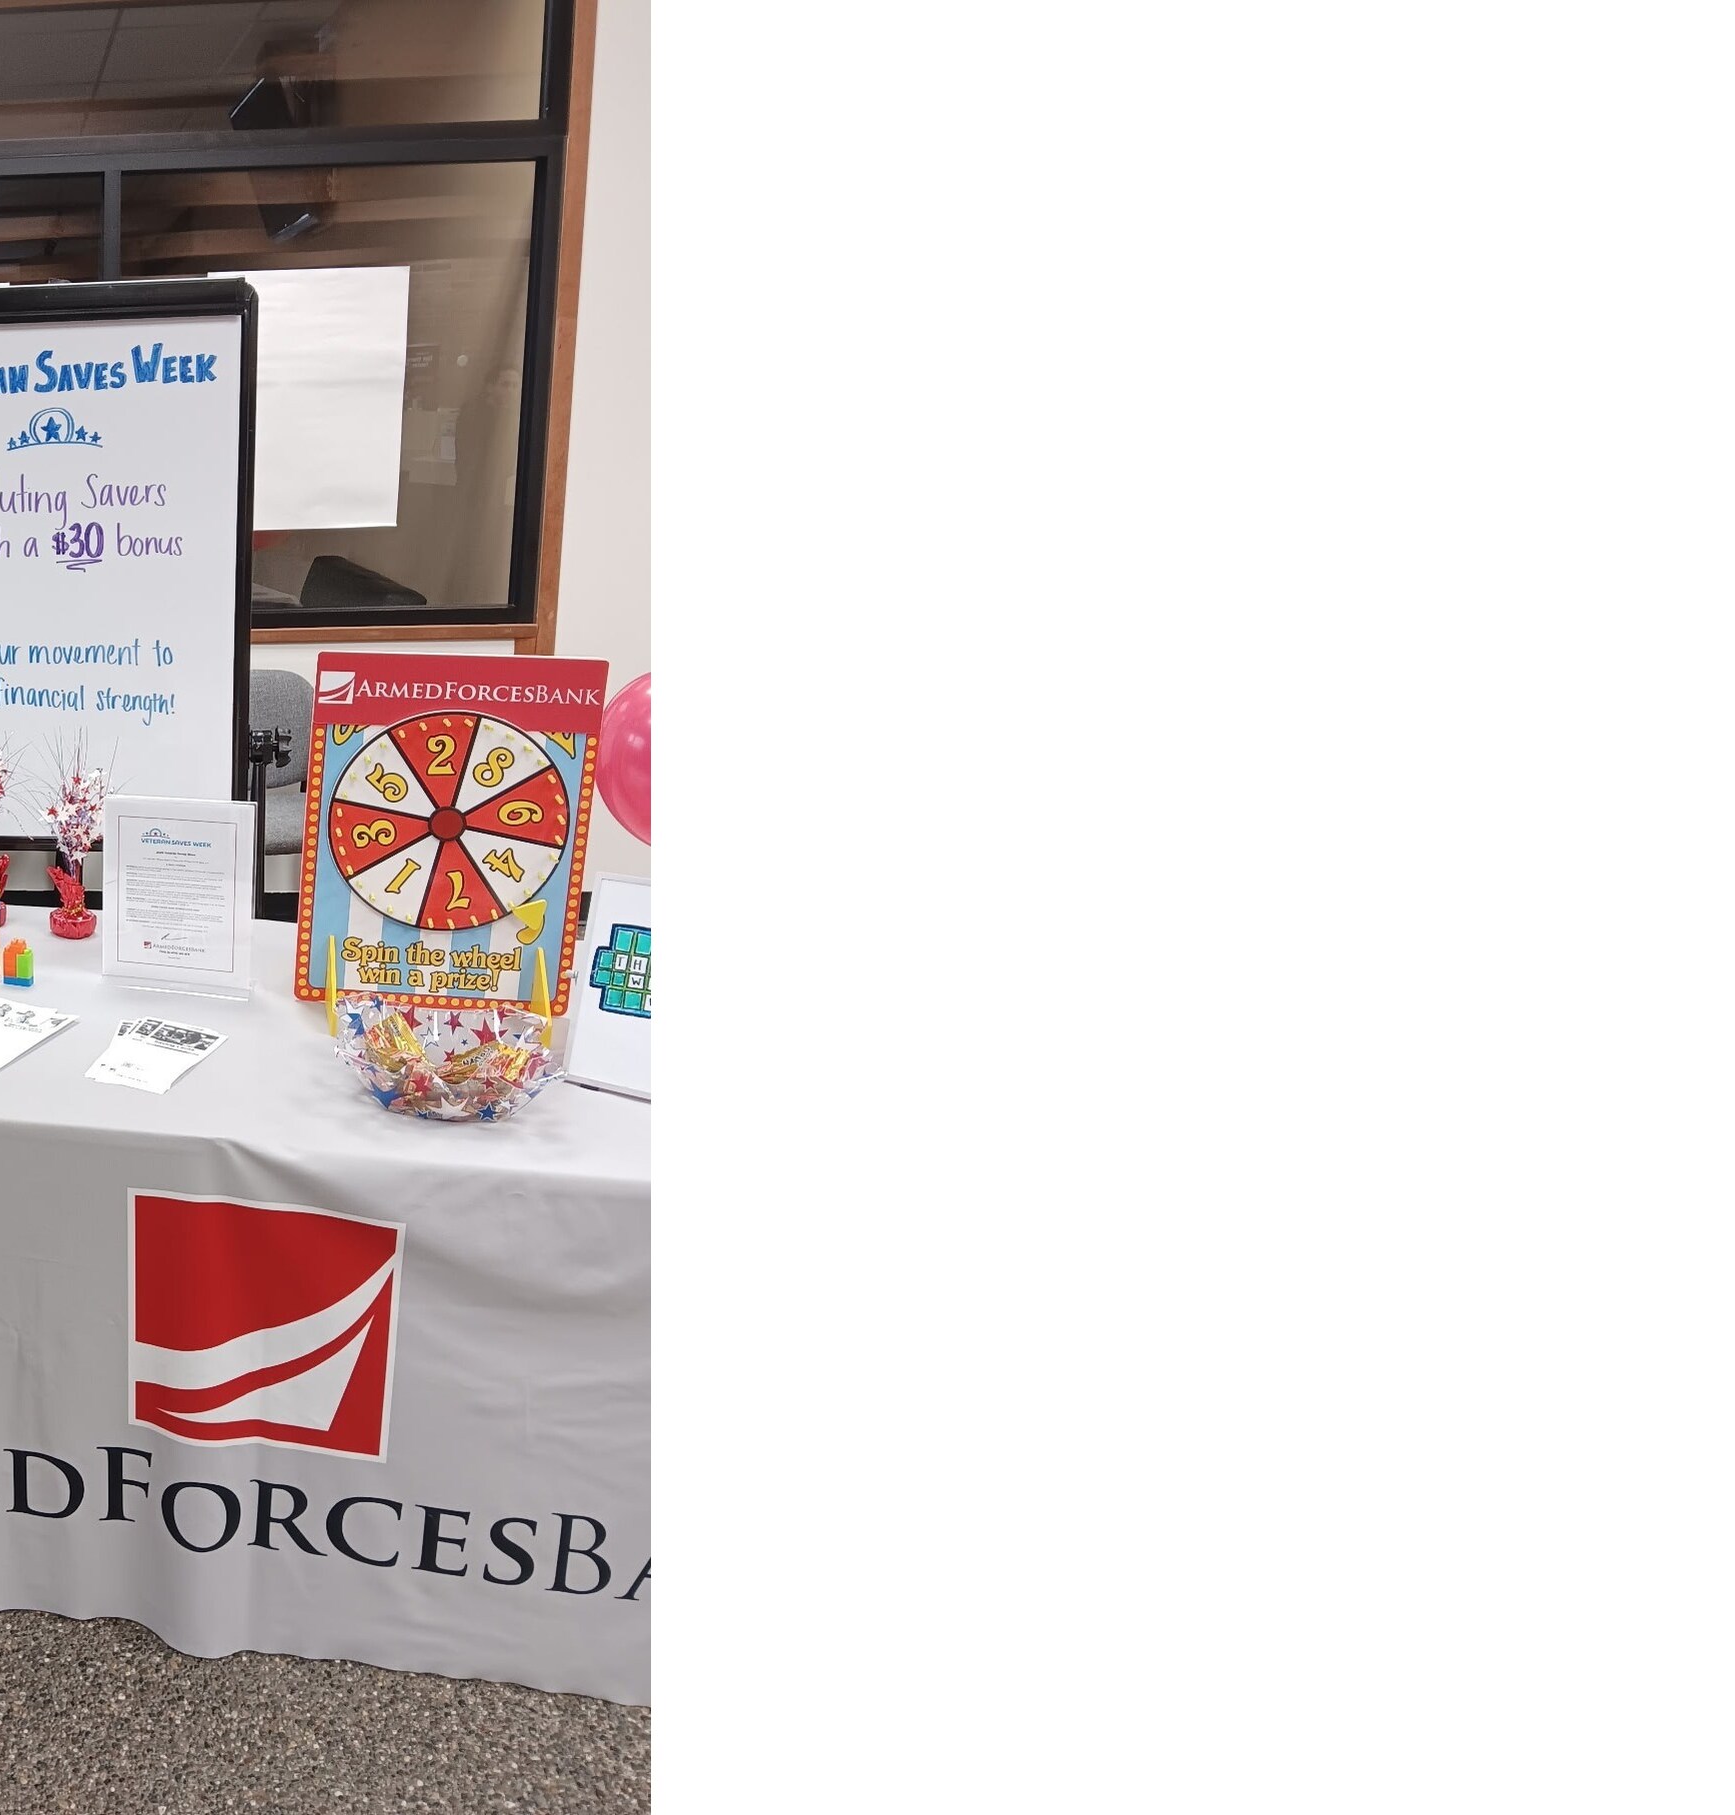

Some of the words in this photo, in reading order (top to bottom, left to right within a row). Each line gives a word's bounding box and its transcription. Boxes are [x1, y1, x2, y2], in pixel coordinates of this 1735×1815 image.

[33, 350, 127, 394] SAVES
[130, 342, 218, 384] WEEK
[80, 473, 167, 508] Savers
[23, 537, 40, 558] a
[51, 521, 105, 559] $30
[116, 524, 183, 558] bonus
[28, 637, 142, 667] movement
[151, 639, 175, 667] to
[95, 687, 176, 727] strength!
[426, 734, 457, 776] 2
[473, 747, 515, 787] 8
[366, 762, 408, 802] 5
[497, 800, 544, 826] 6
[140, 838, 172, 846] VETERAN
[351, 818, 397, 848] 3
[385, 858, 421, 894] 1
[482, 848, 525, 882] 4
[445, 870, 471, 911] 7
[341, 936, 400, 966] Spin
[405, 940, 446, 967] the
[450, 944, 523, 972] wheel
[357, 963, 402, 986] win
[407, 968, 425, 987] a
[429, 969, 501, 993] prize!
